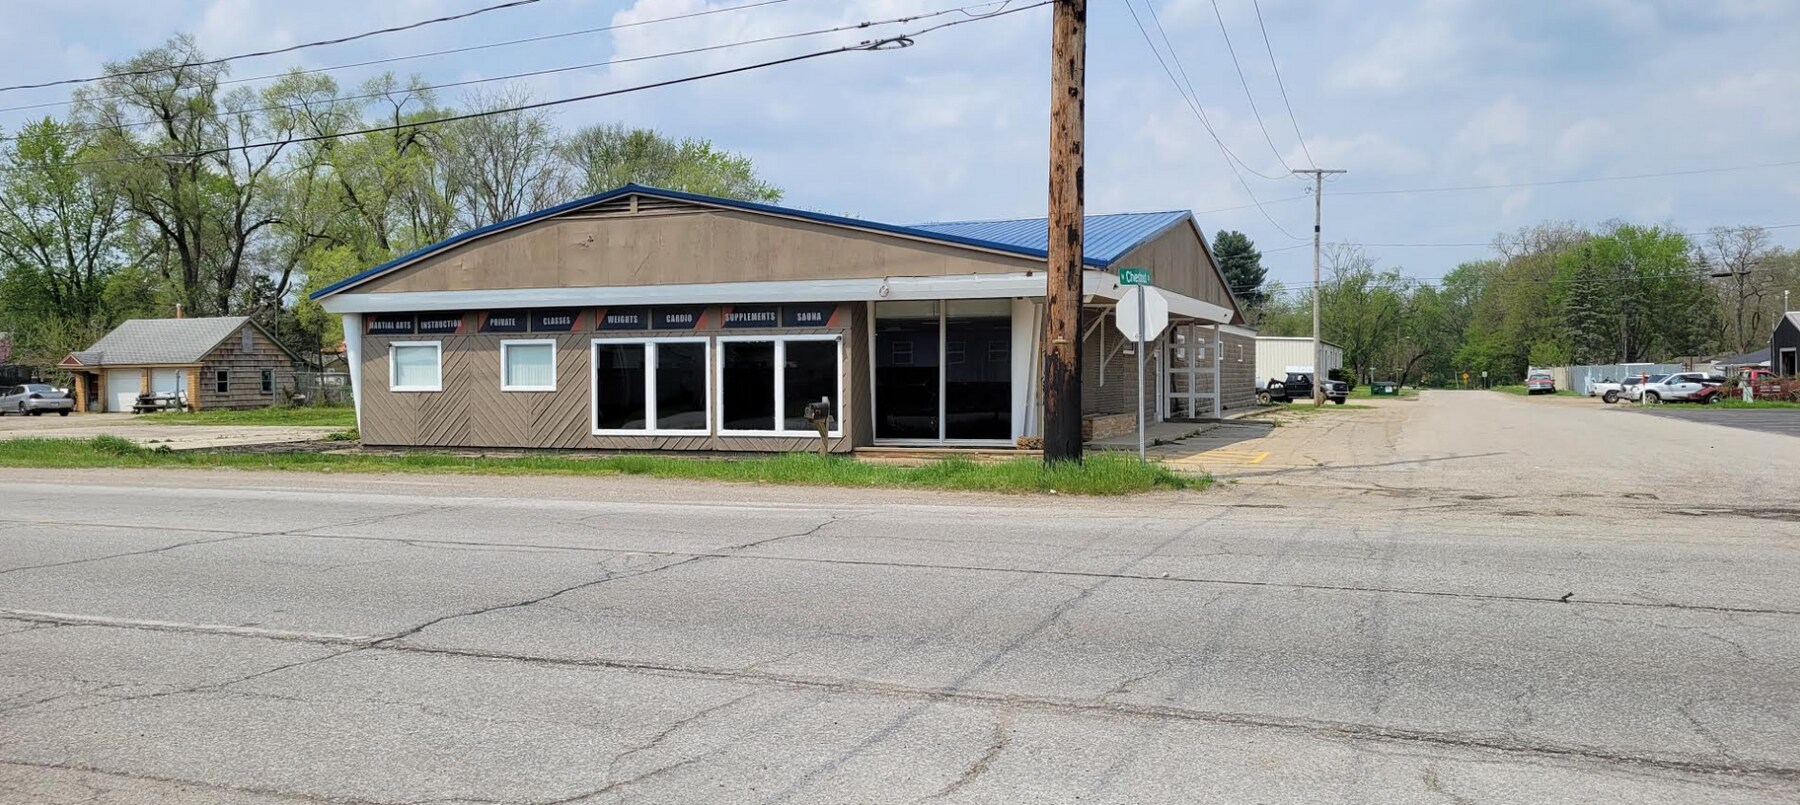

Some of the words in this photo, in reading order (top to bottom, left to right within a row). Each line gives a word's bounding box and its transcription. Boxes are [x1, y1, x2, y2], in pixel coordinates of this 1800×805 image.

[543, 316, 571, 325] CLASSES
[607, 315, 638, 324] WEIGHTS
[666, 314, 693, 323] CARDIO
[725, 312, 776, 322] SUPPLEMENTS
[797, 312, 822, 321] SAUNA
[369, 321, 394, 329] MARTIAL
[396, 321, 411, 329] ARTS
[420, 319, 462, 329] INSTRUCTION
[490, 318, 516, 326] PRIVATE
